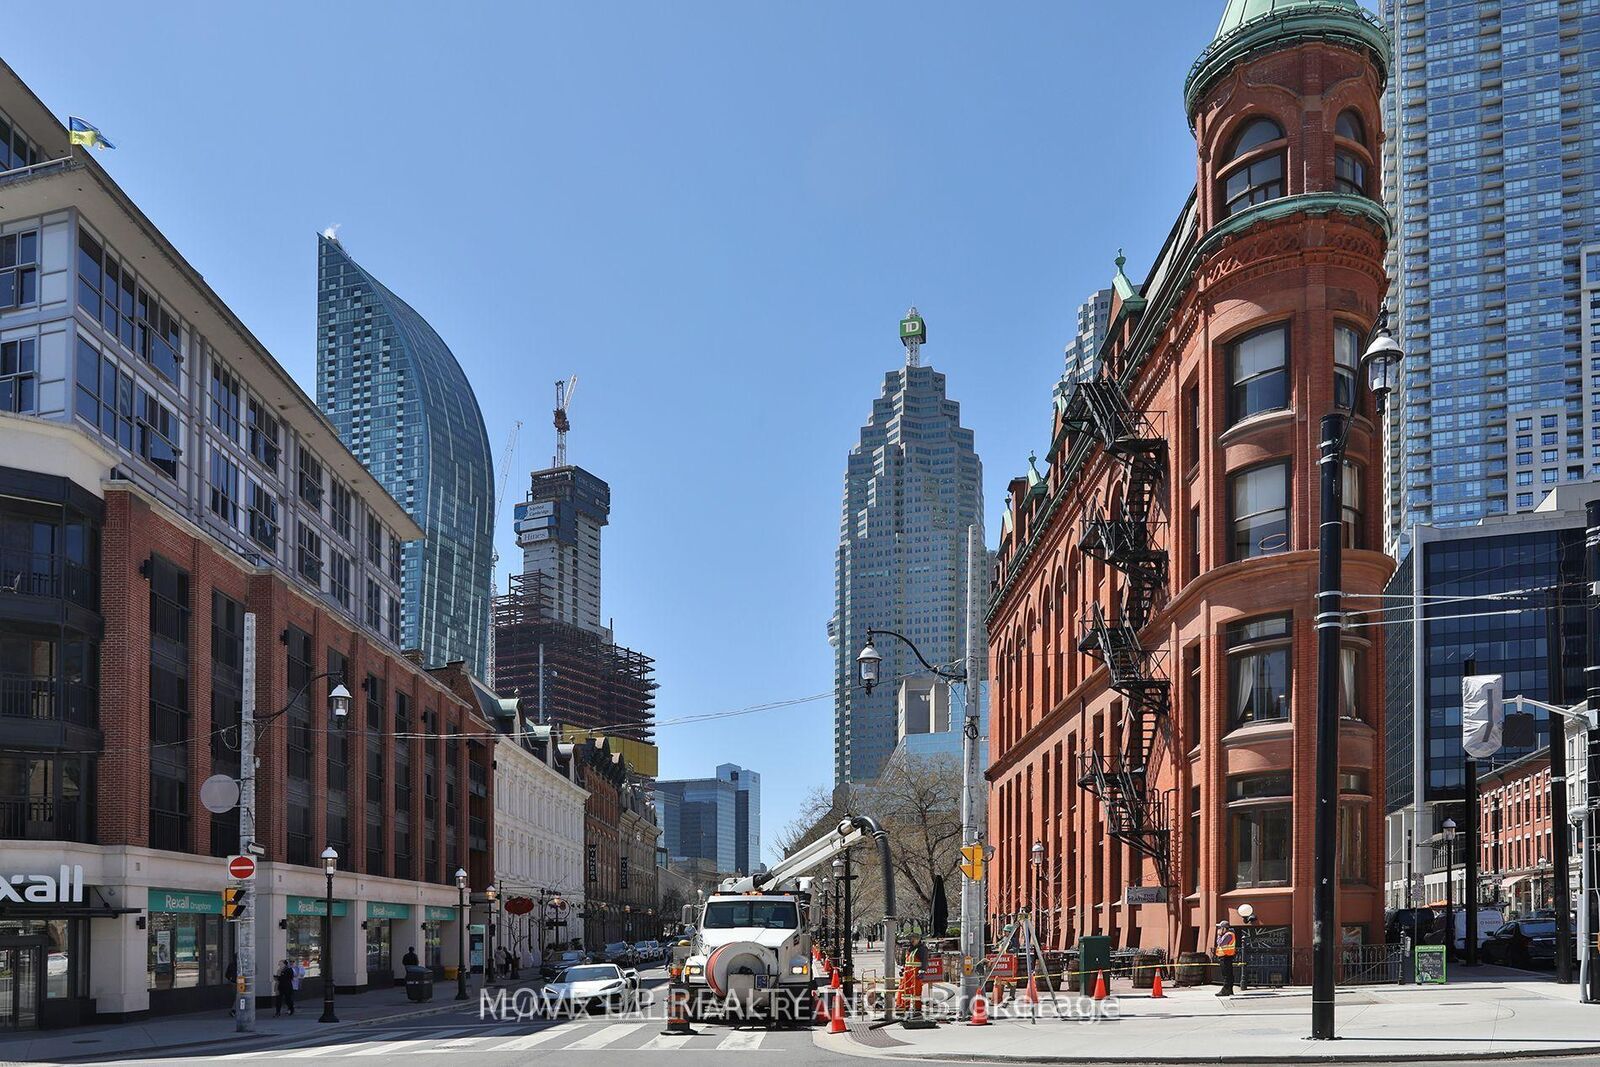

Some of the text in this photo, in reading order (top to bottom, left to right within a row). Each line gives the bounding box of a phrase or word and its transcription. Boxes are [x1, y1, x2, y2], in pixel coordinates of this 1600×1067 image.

[902, 321, 920, 333] TD
[524, 533, 546, 541] Hines
[165, 895, 189, 909] Rexall
